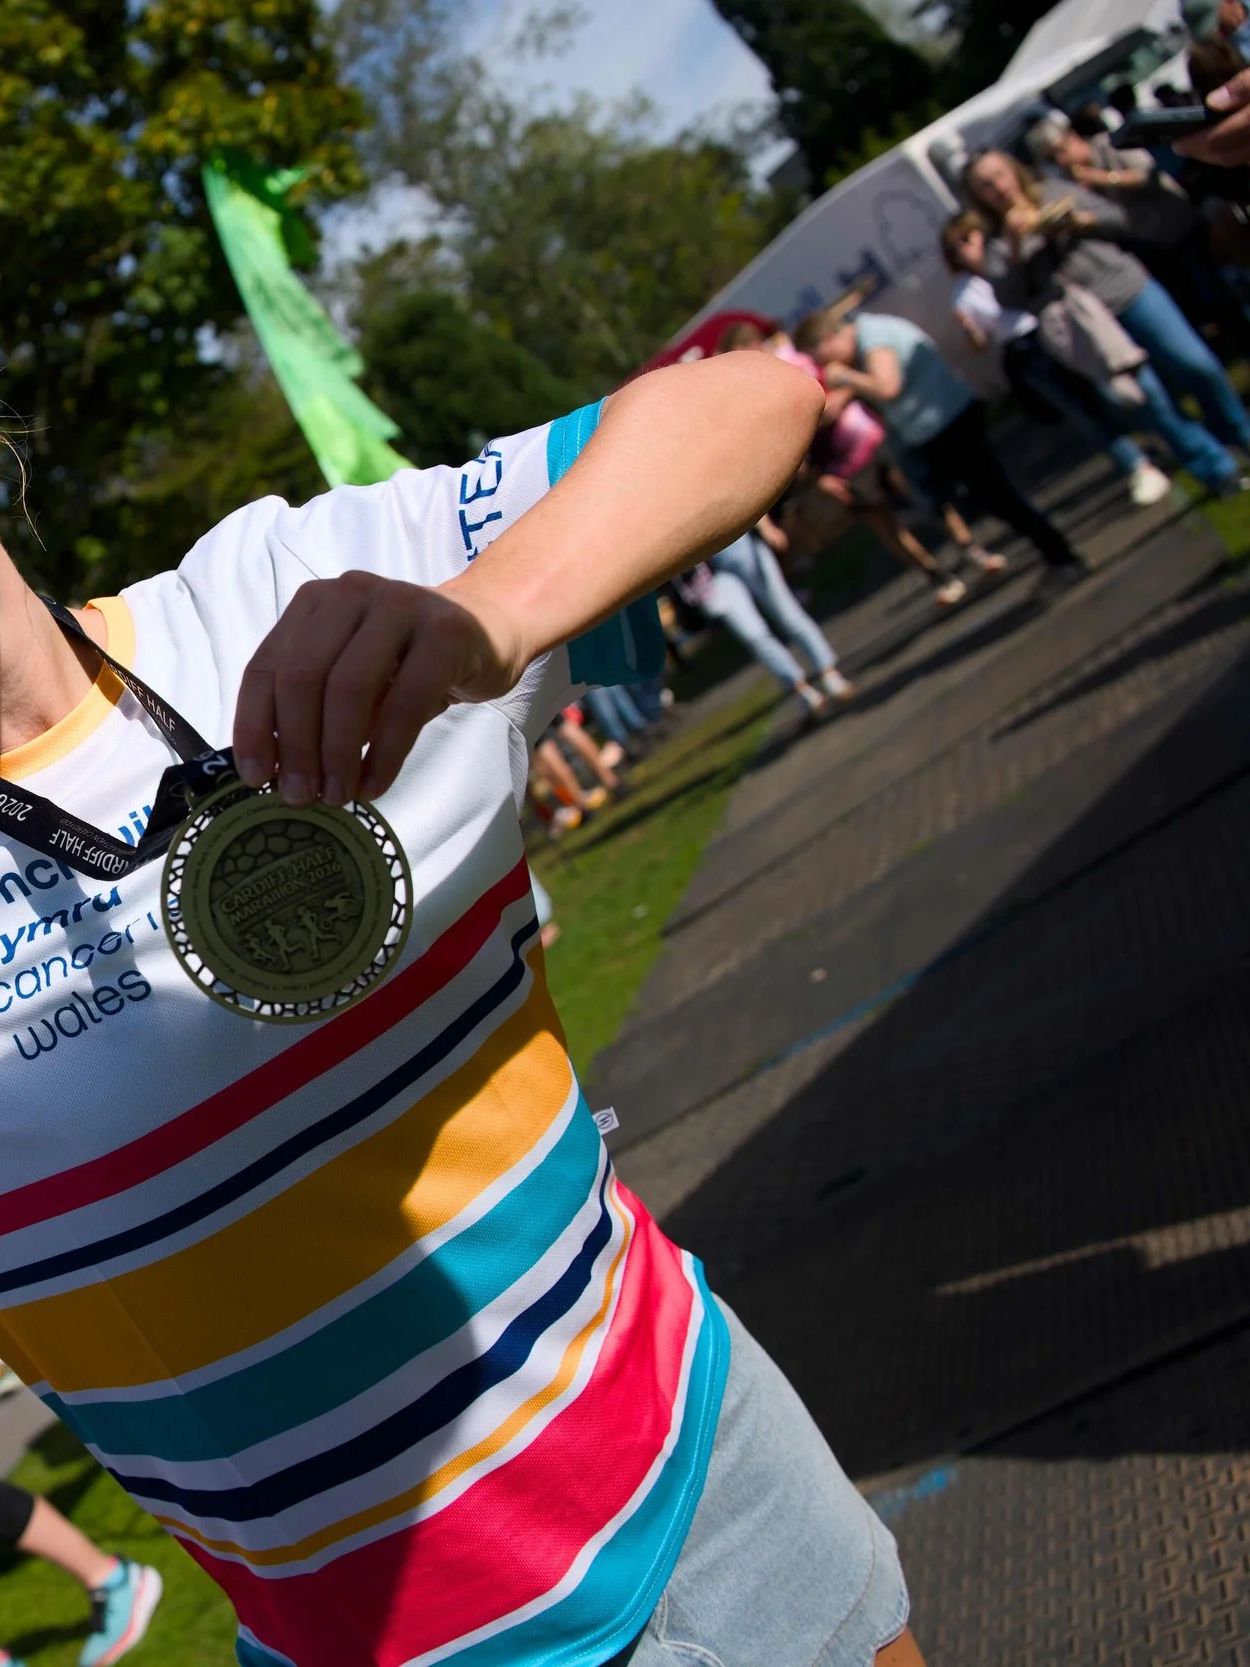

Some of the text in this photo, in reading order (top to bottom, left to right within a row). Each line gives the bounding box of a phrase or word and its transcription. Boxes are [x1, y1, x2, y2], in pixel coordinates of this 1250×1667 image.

[146, 693, 177, 733] HALF
[49, 828, 86, 857] HALF
[221, 868, 287, 914] CARDIFF
[293, 846, 336, 876] HALF
[231, 878, 306, 927] MARATHON
[309, 862, 342, 884] 2026
[12, 969, 152, 1061] wales
